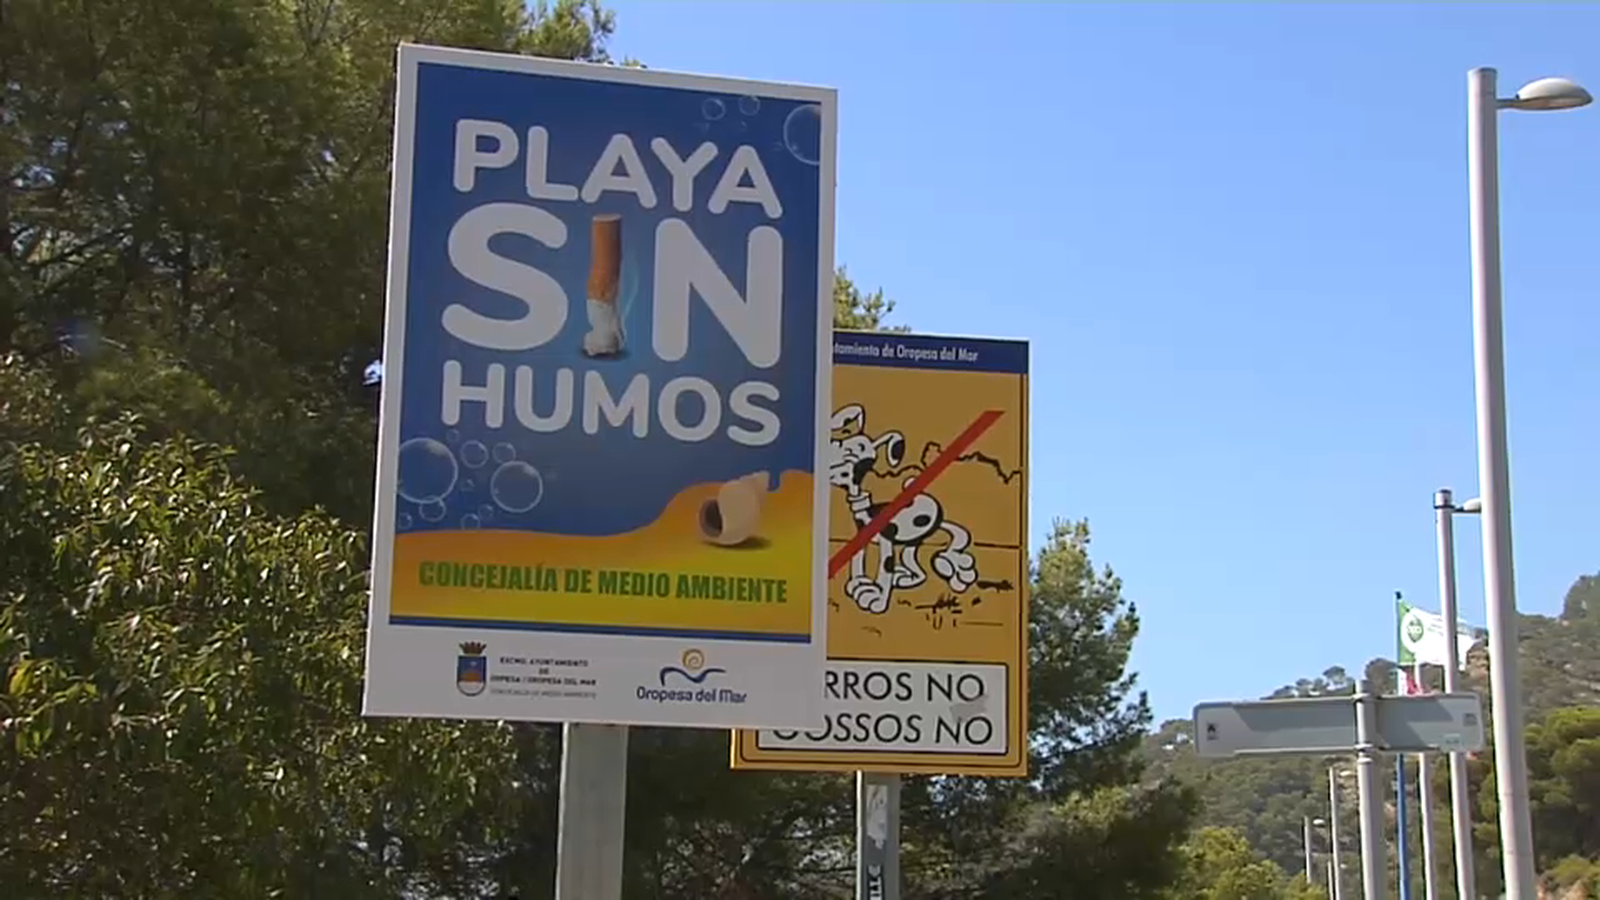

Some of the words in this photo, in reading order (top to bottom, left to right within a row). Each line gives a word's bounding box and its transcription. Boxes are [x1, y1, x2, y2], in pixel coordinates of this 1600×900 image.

[453, 119, 783, 219] PLAYA
[441, 202, 784, 368] SIN
[882, 343, 895, 358] de
[896, 344, 938, 362] Oropesa
[939, 346, 956, 361] del
[958, 348, 979, 362] Mar
[441, 359, 782, 447] HUMOS
[418, 560, 559, 592] CONCEJALÍA
[564, 568, 592, 594] DE
[598, 571, 671, 598] MEDIO
[675, 574, 788, 604] AMBIENTE
[636, 686, 693, 703] Oropesa
[695, 688, 716, 702] del
[719, 688, 747, 703] Mar
[927, 672, 985, 702] NO
[773, 712, 923, 744] OSSOS
[934, 715, 993, 746] NO
